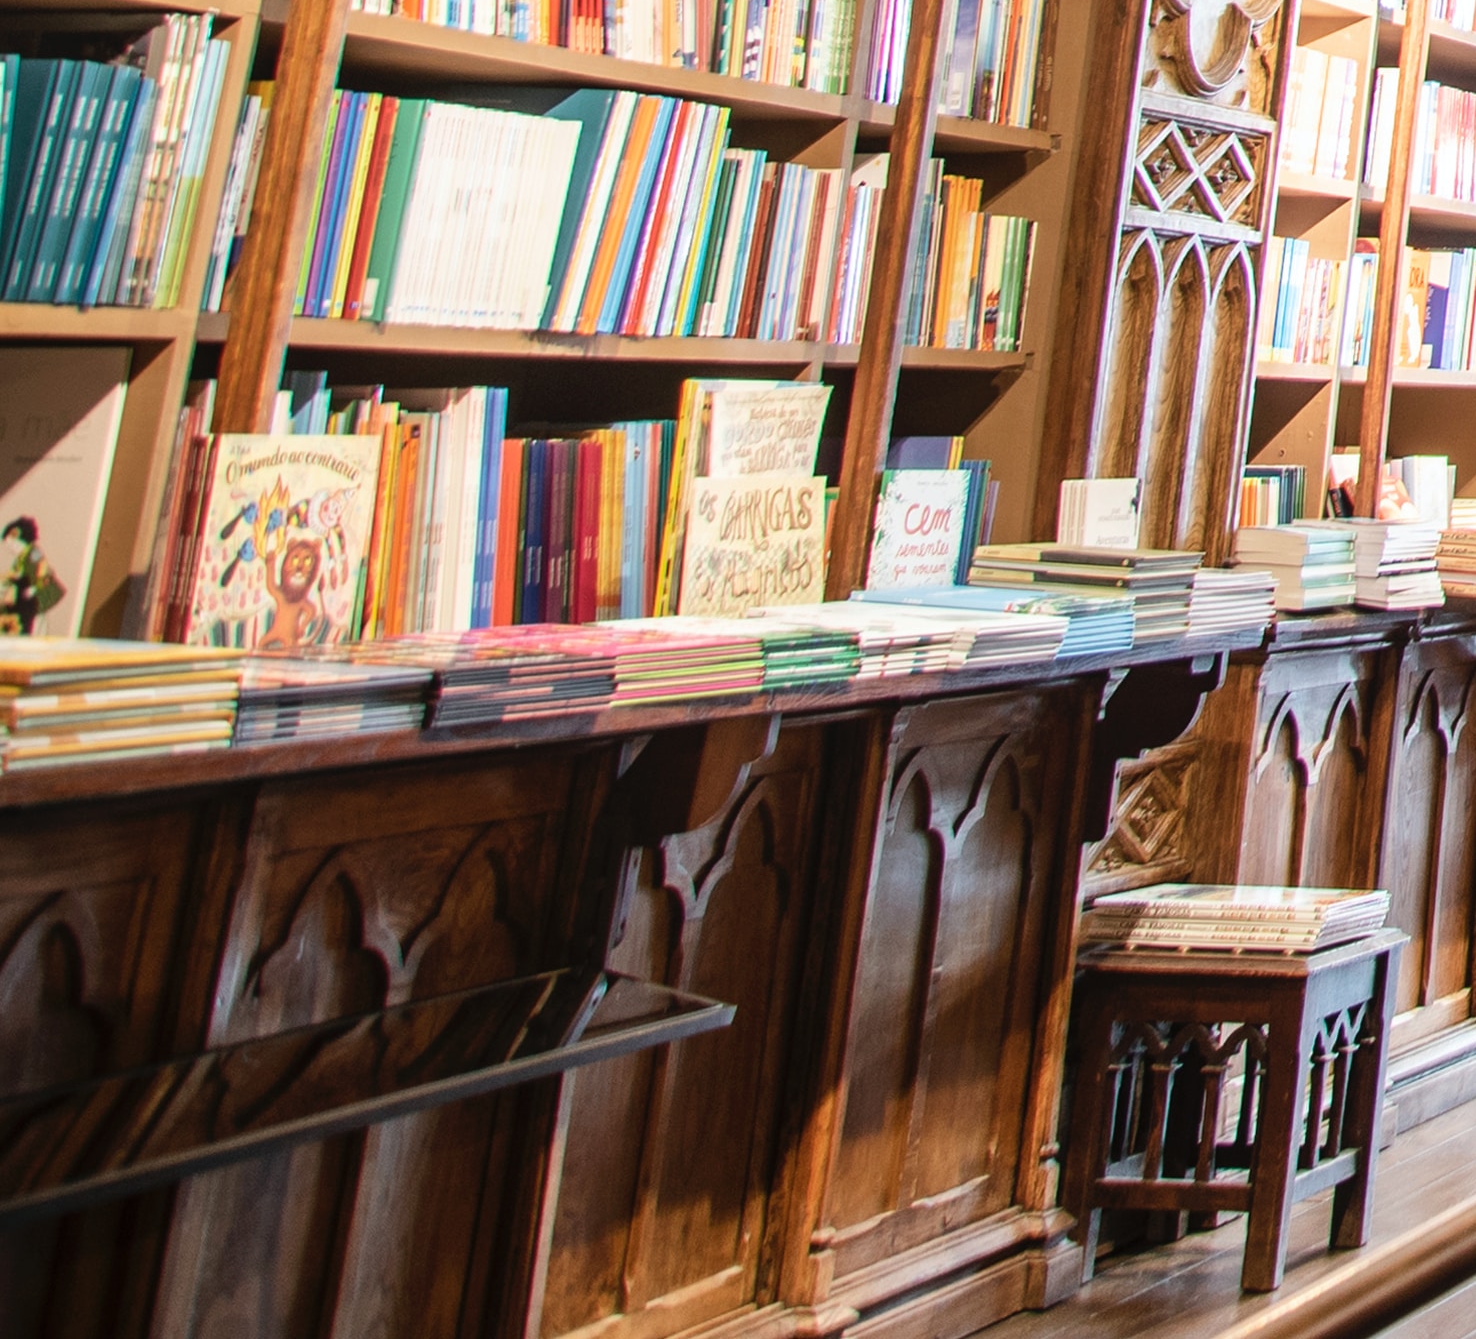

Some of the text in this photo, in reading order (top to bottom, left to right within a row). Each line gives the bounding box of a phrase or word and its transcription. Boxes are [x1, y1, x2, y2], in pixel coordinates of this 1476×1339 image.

[226, 460, 238, 485] O
[239, 444, 287, 477] mundo
[288, 451, 304, 465] ao
[896, 539, 950, 558] sementes
